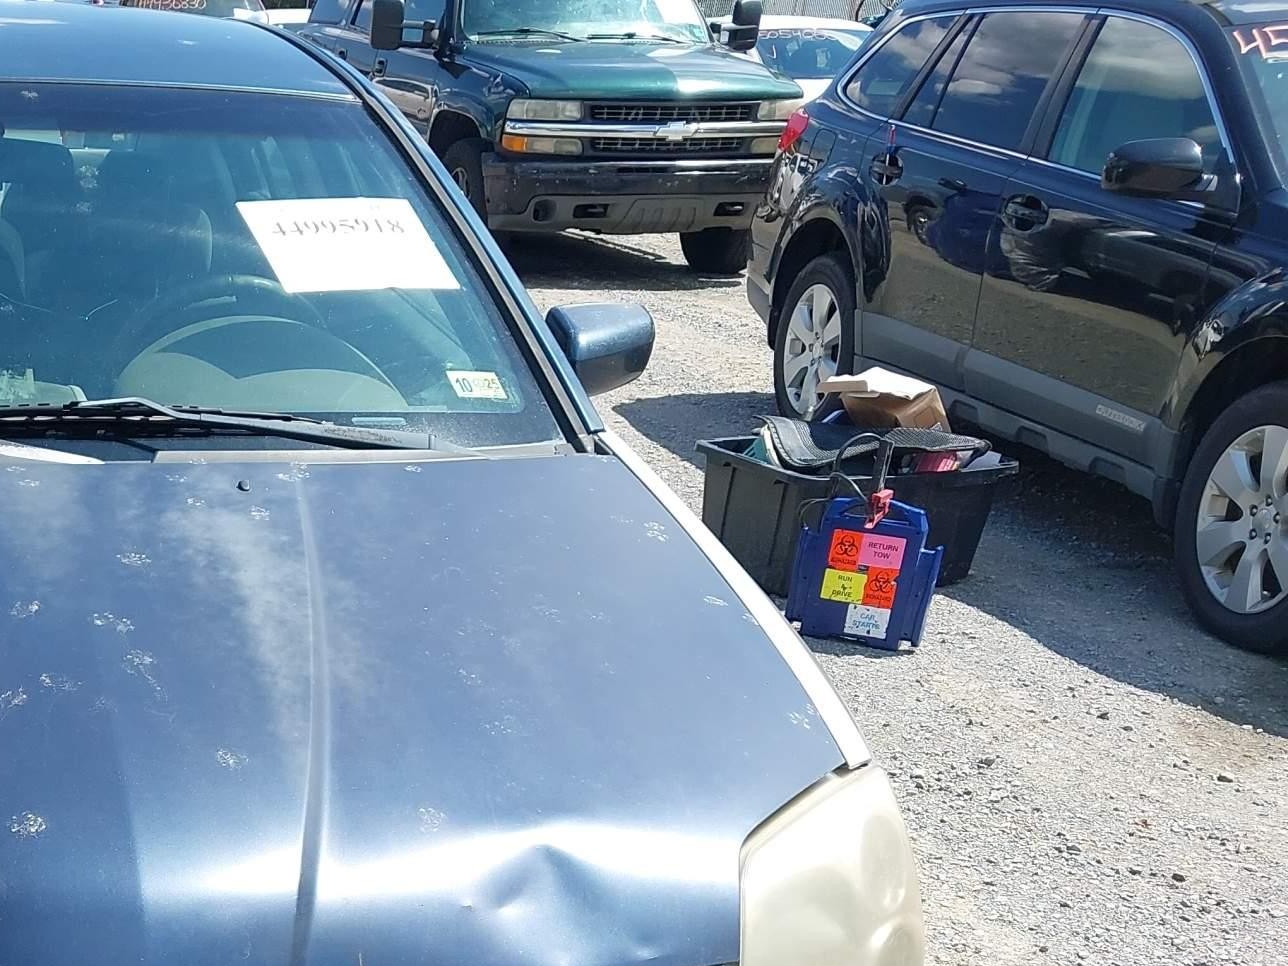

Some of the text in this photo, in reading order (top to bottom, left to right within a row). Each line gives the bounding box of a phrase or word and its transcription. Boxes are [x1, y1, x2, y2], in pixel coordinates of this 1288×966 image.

[455, 377, 473, 393] 10
[867, 541, 899, 552] RETURN
[873, 550, 891, 560] TOW
[838, 574, 853, 583] RUN
[831, 589, 853, 598] DRIVE
